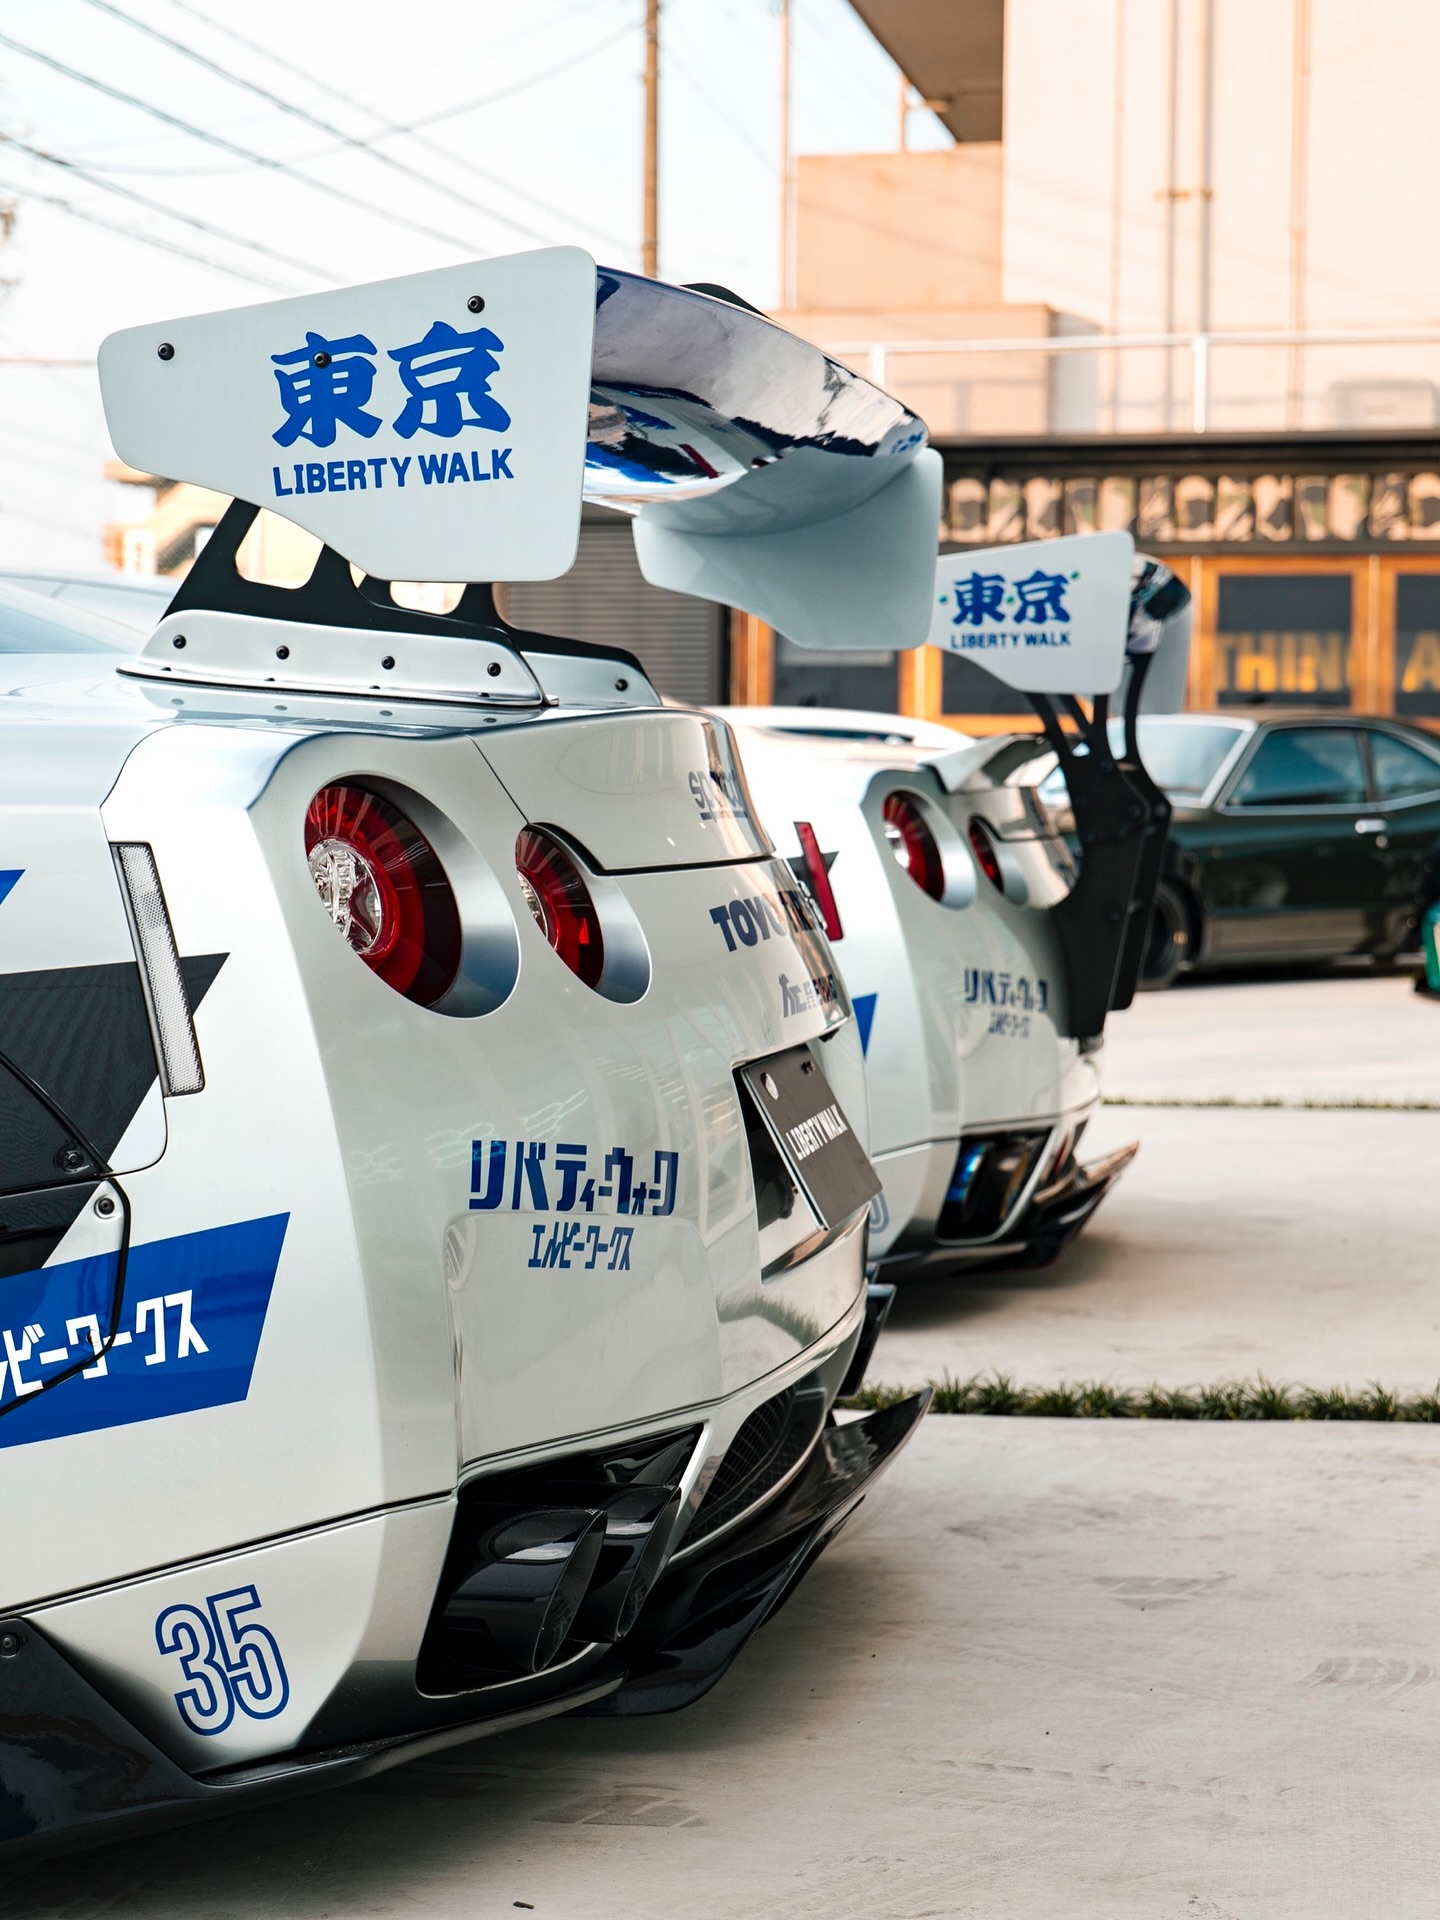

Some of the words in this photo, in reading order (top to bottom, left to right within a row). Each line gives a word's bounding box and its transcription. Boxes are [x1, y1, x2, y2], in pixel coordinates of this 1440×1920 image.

[270, 320, 512, 448] 東京
[272, 456, 412, 497] LIBERTY
[417, 447, 514, 484] WALK
[952, 570, 1071, 626] 東京
[951, 633, 1020, 649] LIBERTY
[1023, 630, 1072, 646] WALK
[709, 892, 788, 952] TOYO
[155, 1584, 290, 1737] 35
